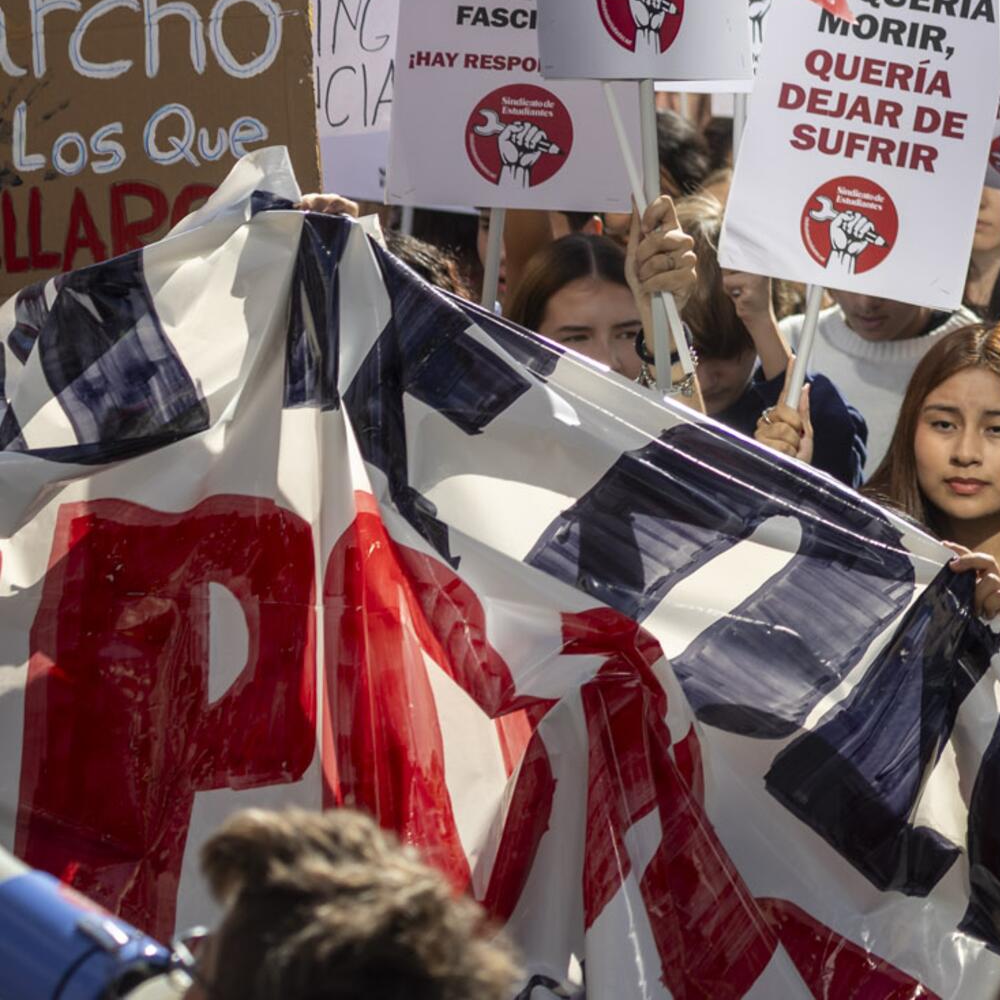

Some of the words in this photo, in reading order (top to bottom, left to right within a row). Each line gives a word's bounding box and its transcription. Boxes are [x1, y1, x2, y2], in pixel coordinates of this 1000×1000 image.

[455, 6, 538, 31] FASCI
[818, 8, 956, 61] MORIR,
[408, 51, 460, 70] ¡HAY
[805, 49, 953, 99] QUERÍA
[777, 82, 901, 129] DEJAR
[913, 107, 969, 140] DE
[12, 101, 126, 176] Los
[143, 103, 269, 167] Que
[789, 124, 939, 174] SUFRIR
